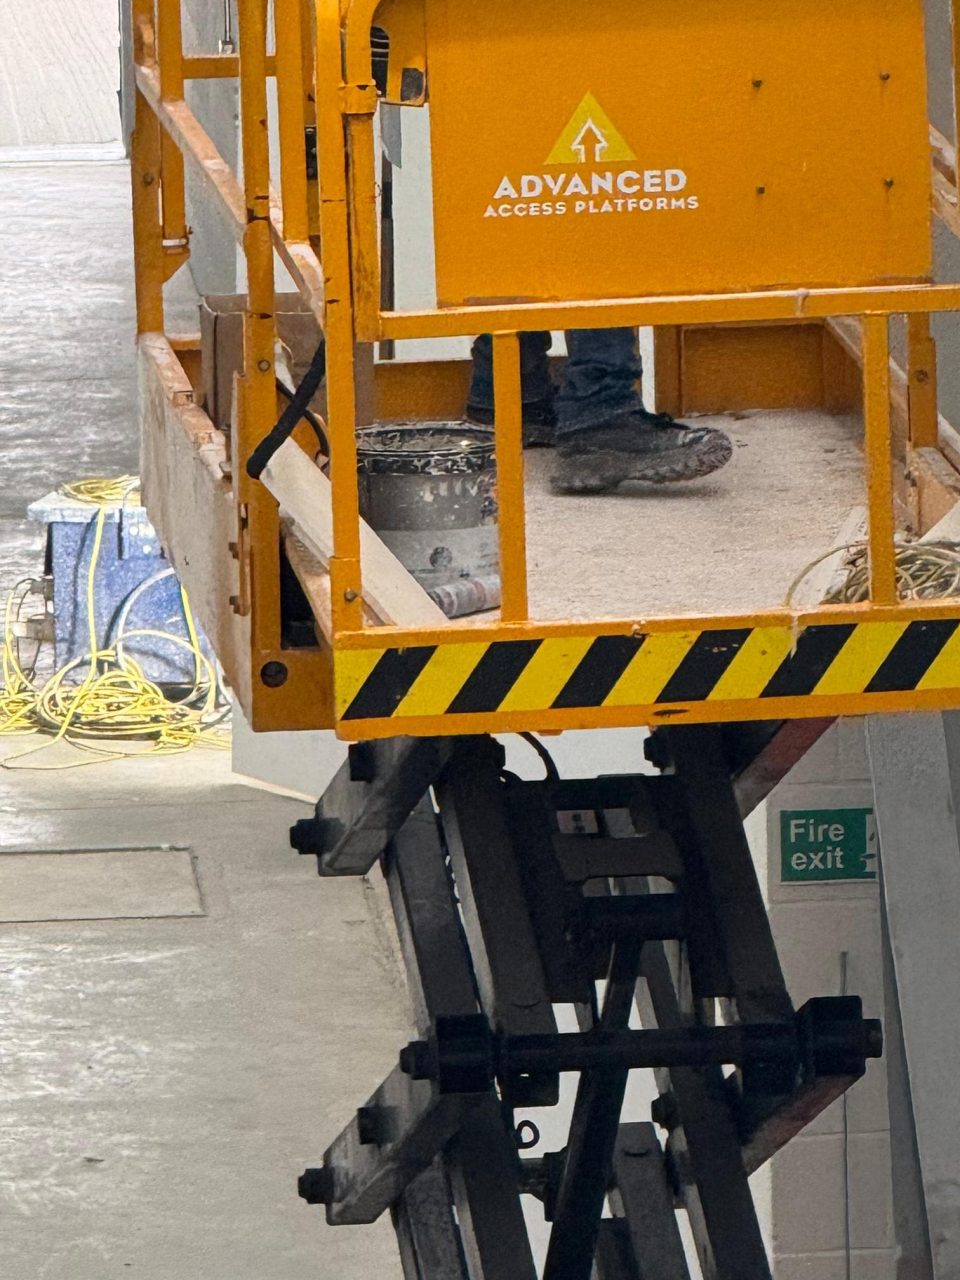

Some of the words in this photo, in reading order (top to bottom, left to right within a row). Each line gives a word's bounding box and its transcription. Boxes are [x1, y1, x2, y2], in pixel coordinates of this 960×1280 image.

[493, 168, 688, 200] ADVANCED
[483, 201, 568, 218] ACCESS
[574, 195, 700, 214] PLATFORMS
[789, 818, 845, 843] Fire
[791, 846, 845, 871] exit
